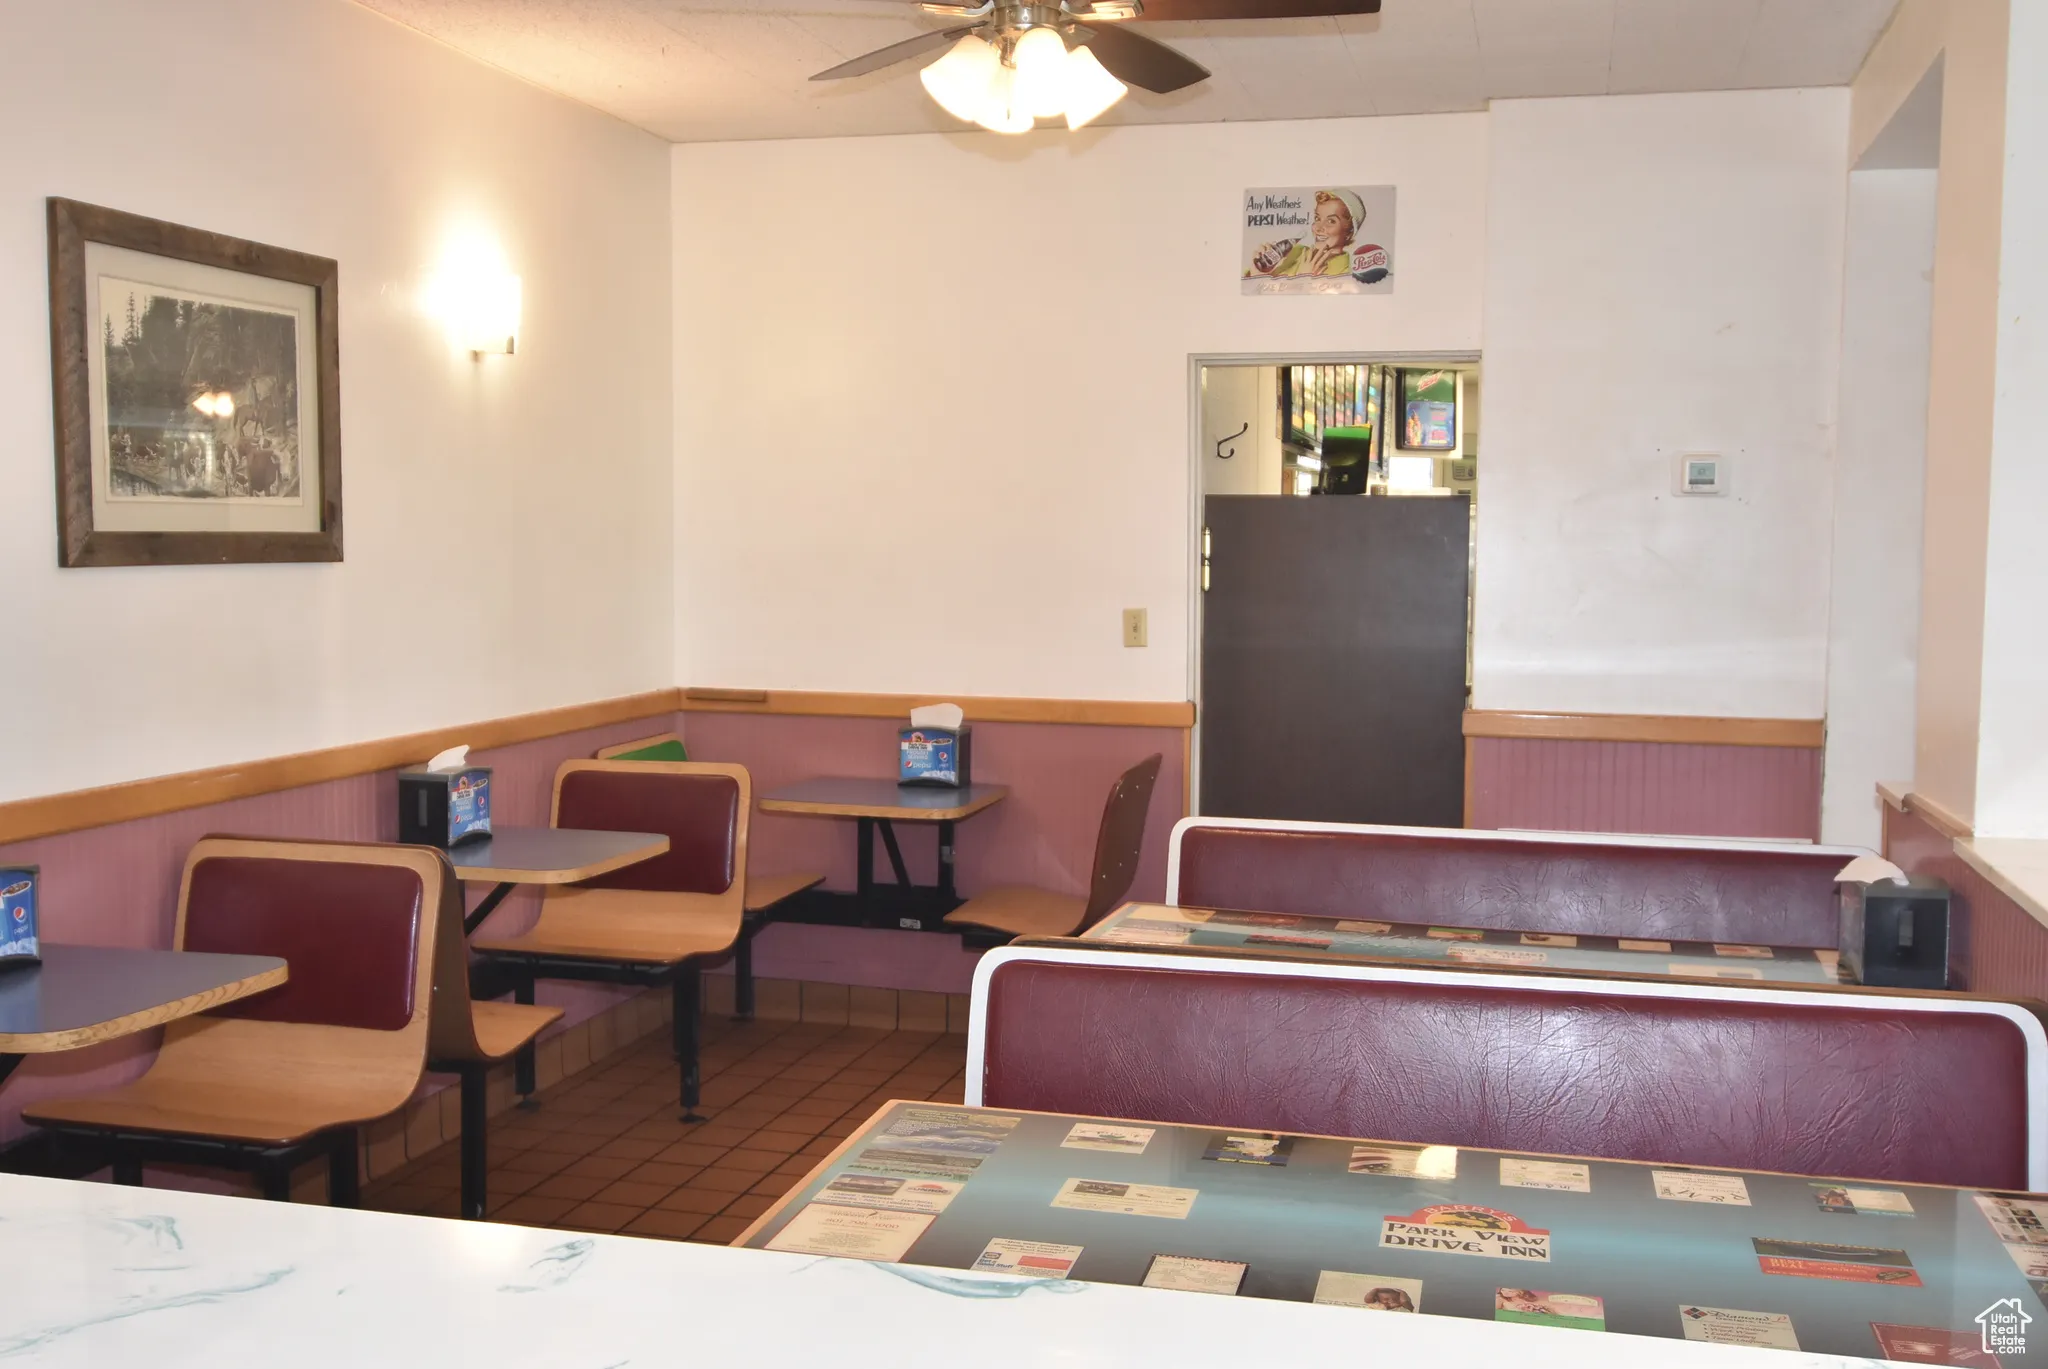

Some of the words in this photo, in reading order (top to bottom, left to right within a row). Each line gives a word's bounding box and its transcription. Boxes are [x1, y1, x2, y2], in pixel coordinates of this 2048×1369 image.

[1246, 196, 1263, 212] Any
[1265, 195, 1302, 209] Weather's
[1248, 215, 1274, 227] PEPSI
[1276, 212, 1310, 226] Weather!
[1423, 1204, 1518, 1222] BARRY'S
[1387, 1222, 1457, 1238] PARK
[1474, 1230, 1546, 1246] VIEW
[1385, 1234, 1484, 1253] DRIVE
[1501, 1245, 1547, 1259] INN
[1707, 1310, 1770, 1320] Diamond
